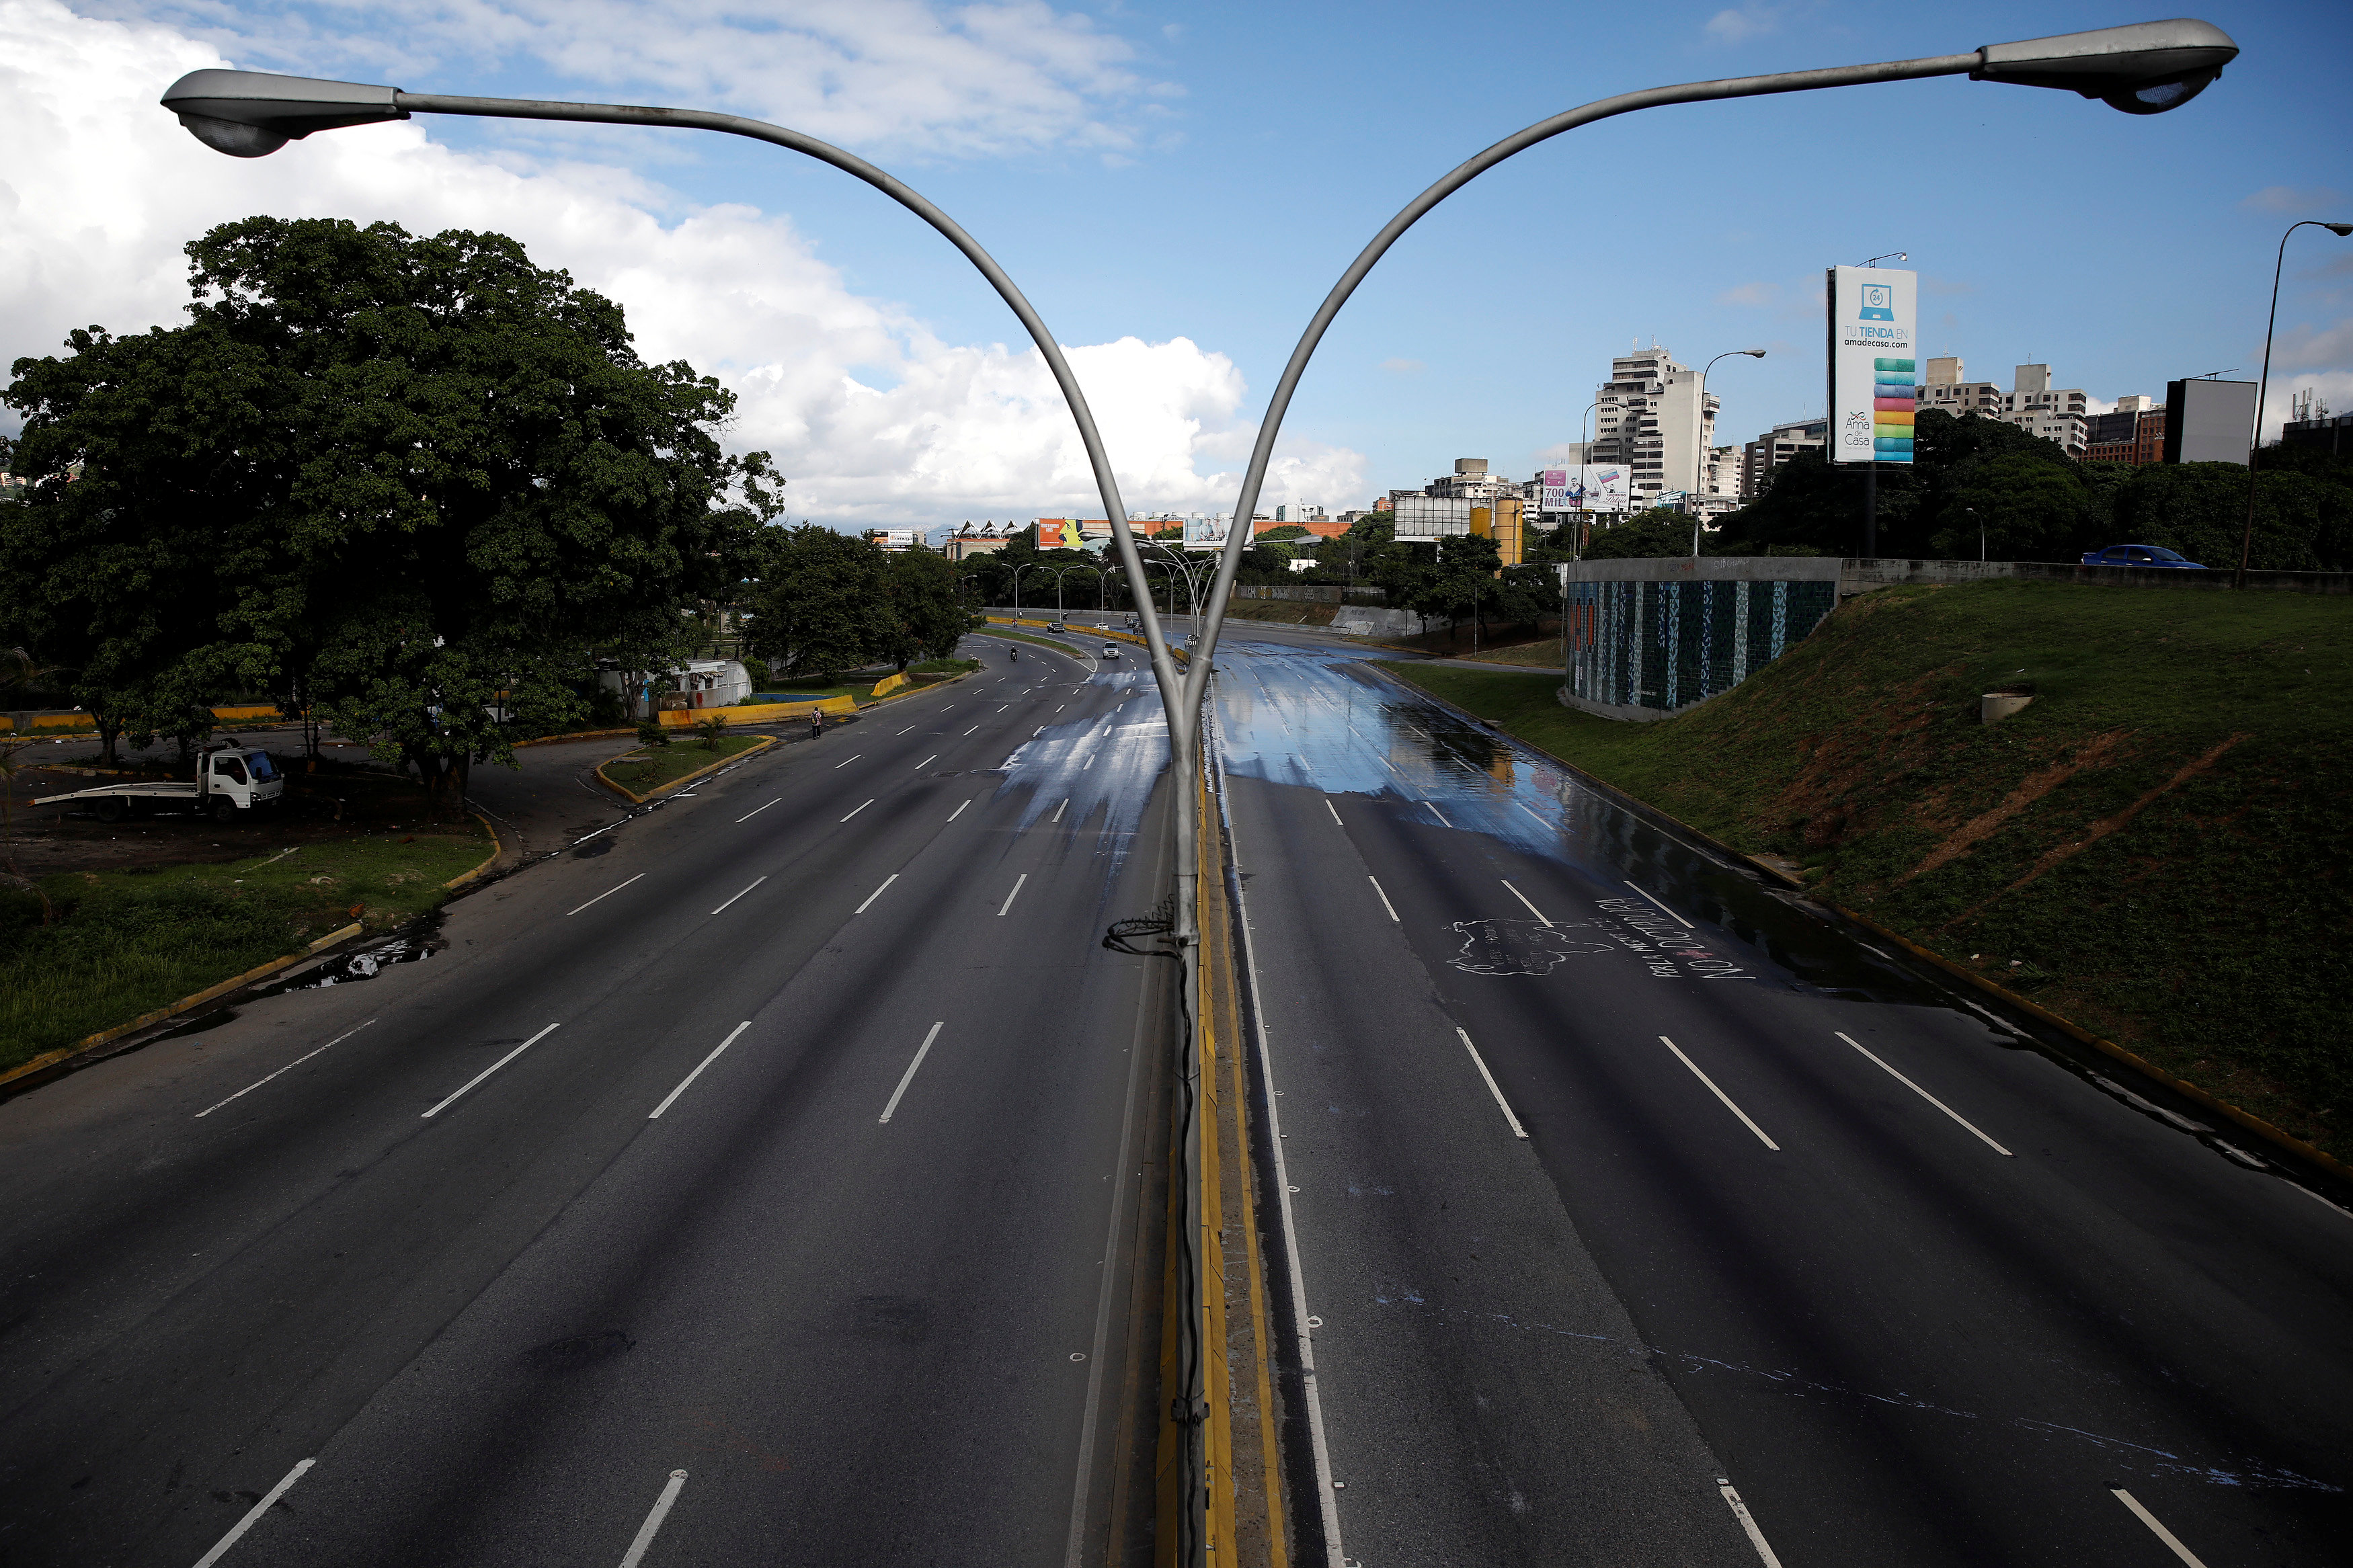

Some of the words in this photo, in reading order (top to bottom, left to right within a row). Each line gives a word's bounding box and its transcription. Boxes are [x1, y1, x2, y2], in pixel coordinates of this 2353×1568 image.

[1844, 325, 1857, 337] TU
[1860, 326, 1895, 339] TIENDA
[1897, 329, 1908, 339] EN
[1844, 338, 1908, 348] amadecasa.com
[1845, 417, 1870, 429] Ama
[1845, 434, 1870, 446] Casa
[1546, 488, 1564, 497] 700
[1545, 498, 1564, 507] MIL
[1595, 897, 1705, 948] DICTADURA
[1687, 960, 1757, 979] NO
